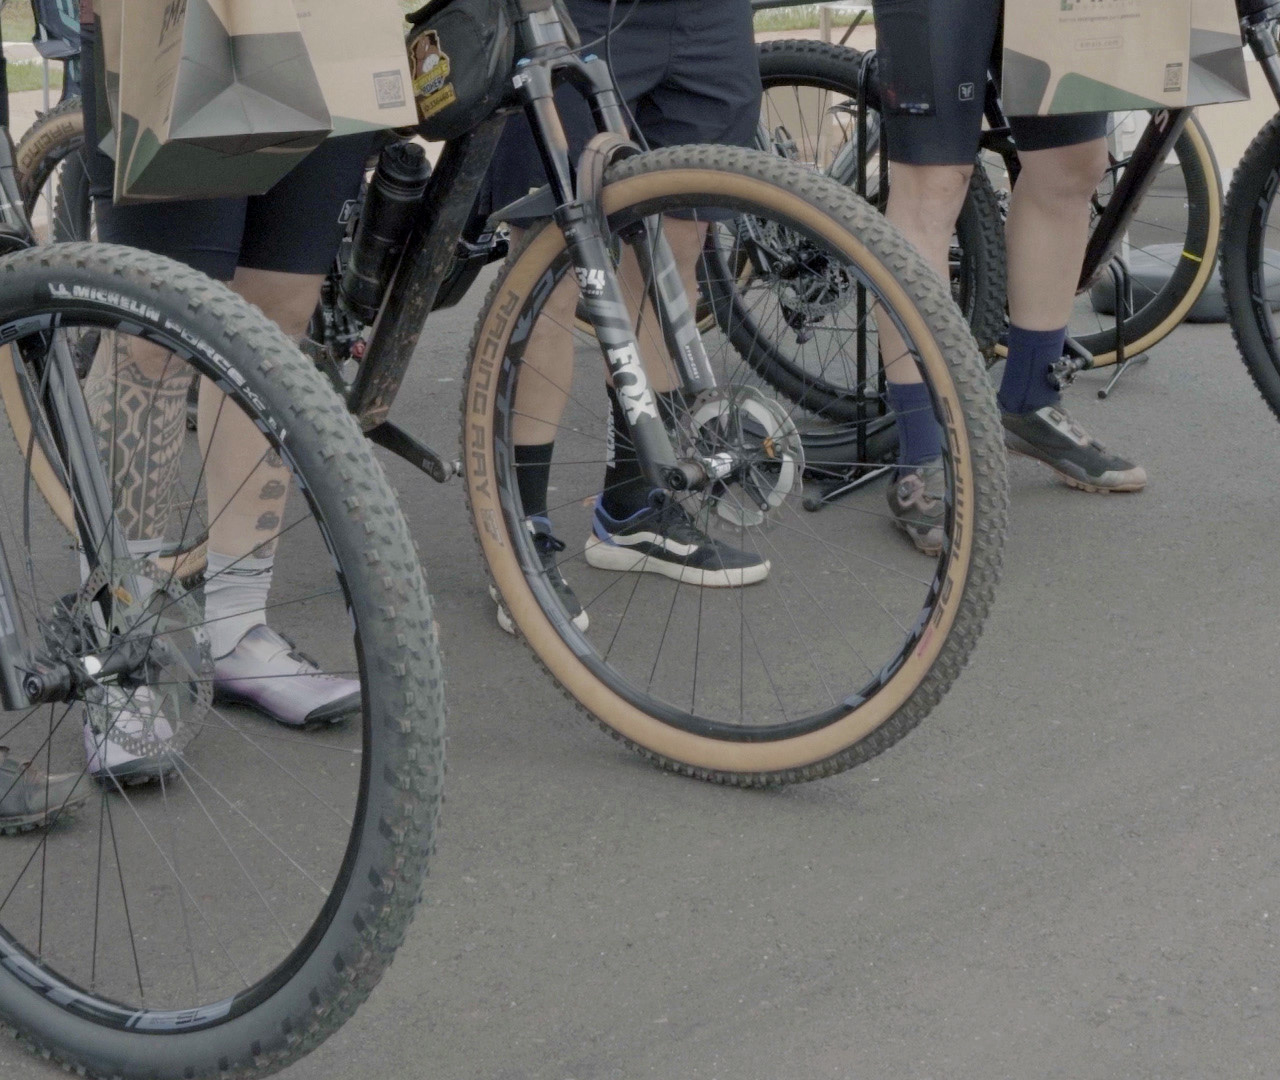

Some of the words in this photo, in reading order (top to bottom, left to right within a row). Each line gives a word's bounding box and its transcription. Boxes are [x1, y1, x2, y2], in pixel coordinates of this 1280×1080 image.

[575, 267, 605, 289] 34
[73, 285, 160, 322] MICHELIN
[164, 320, 246, 387] FORCE
[472, 289, 519, 417] RACING
[607, 342, 658, 426] FOX
[471, 424, 491, 499] RAY
